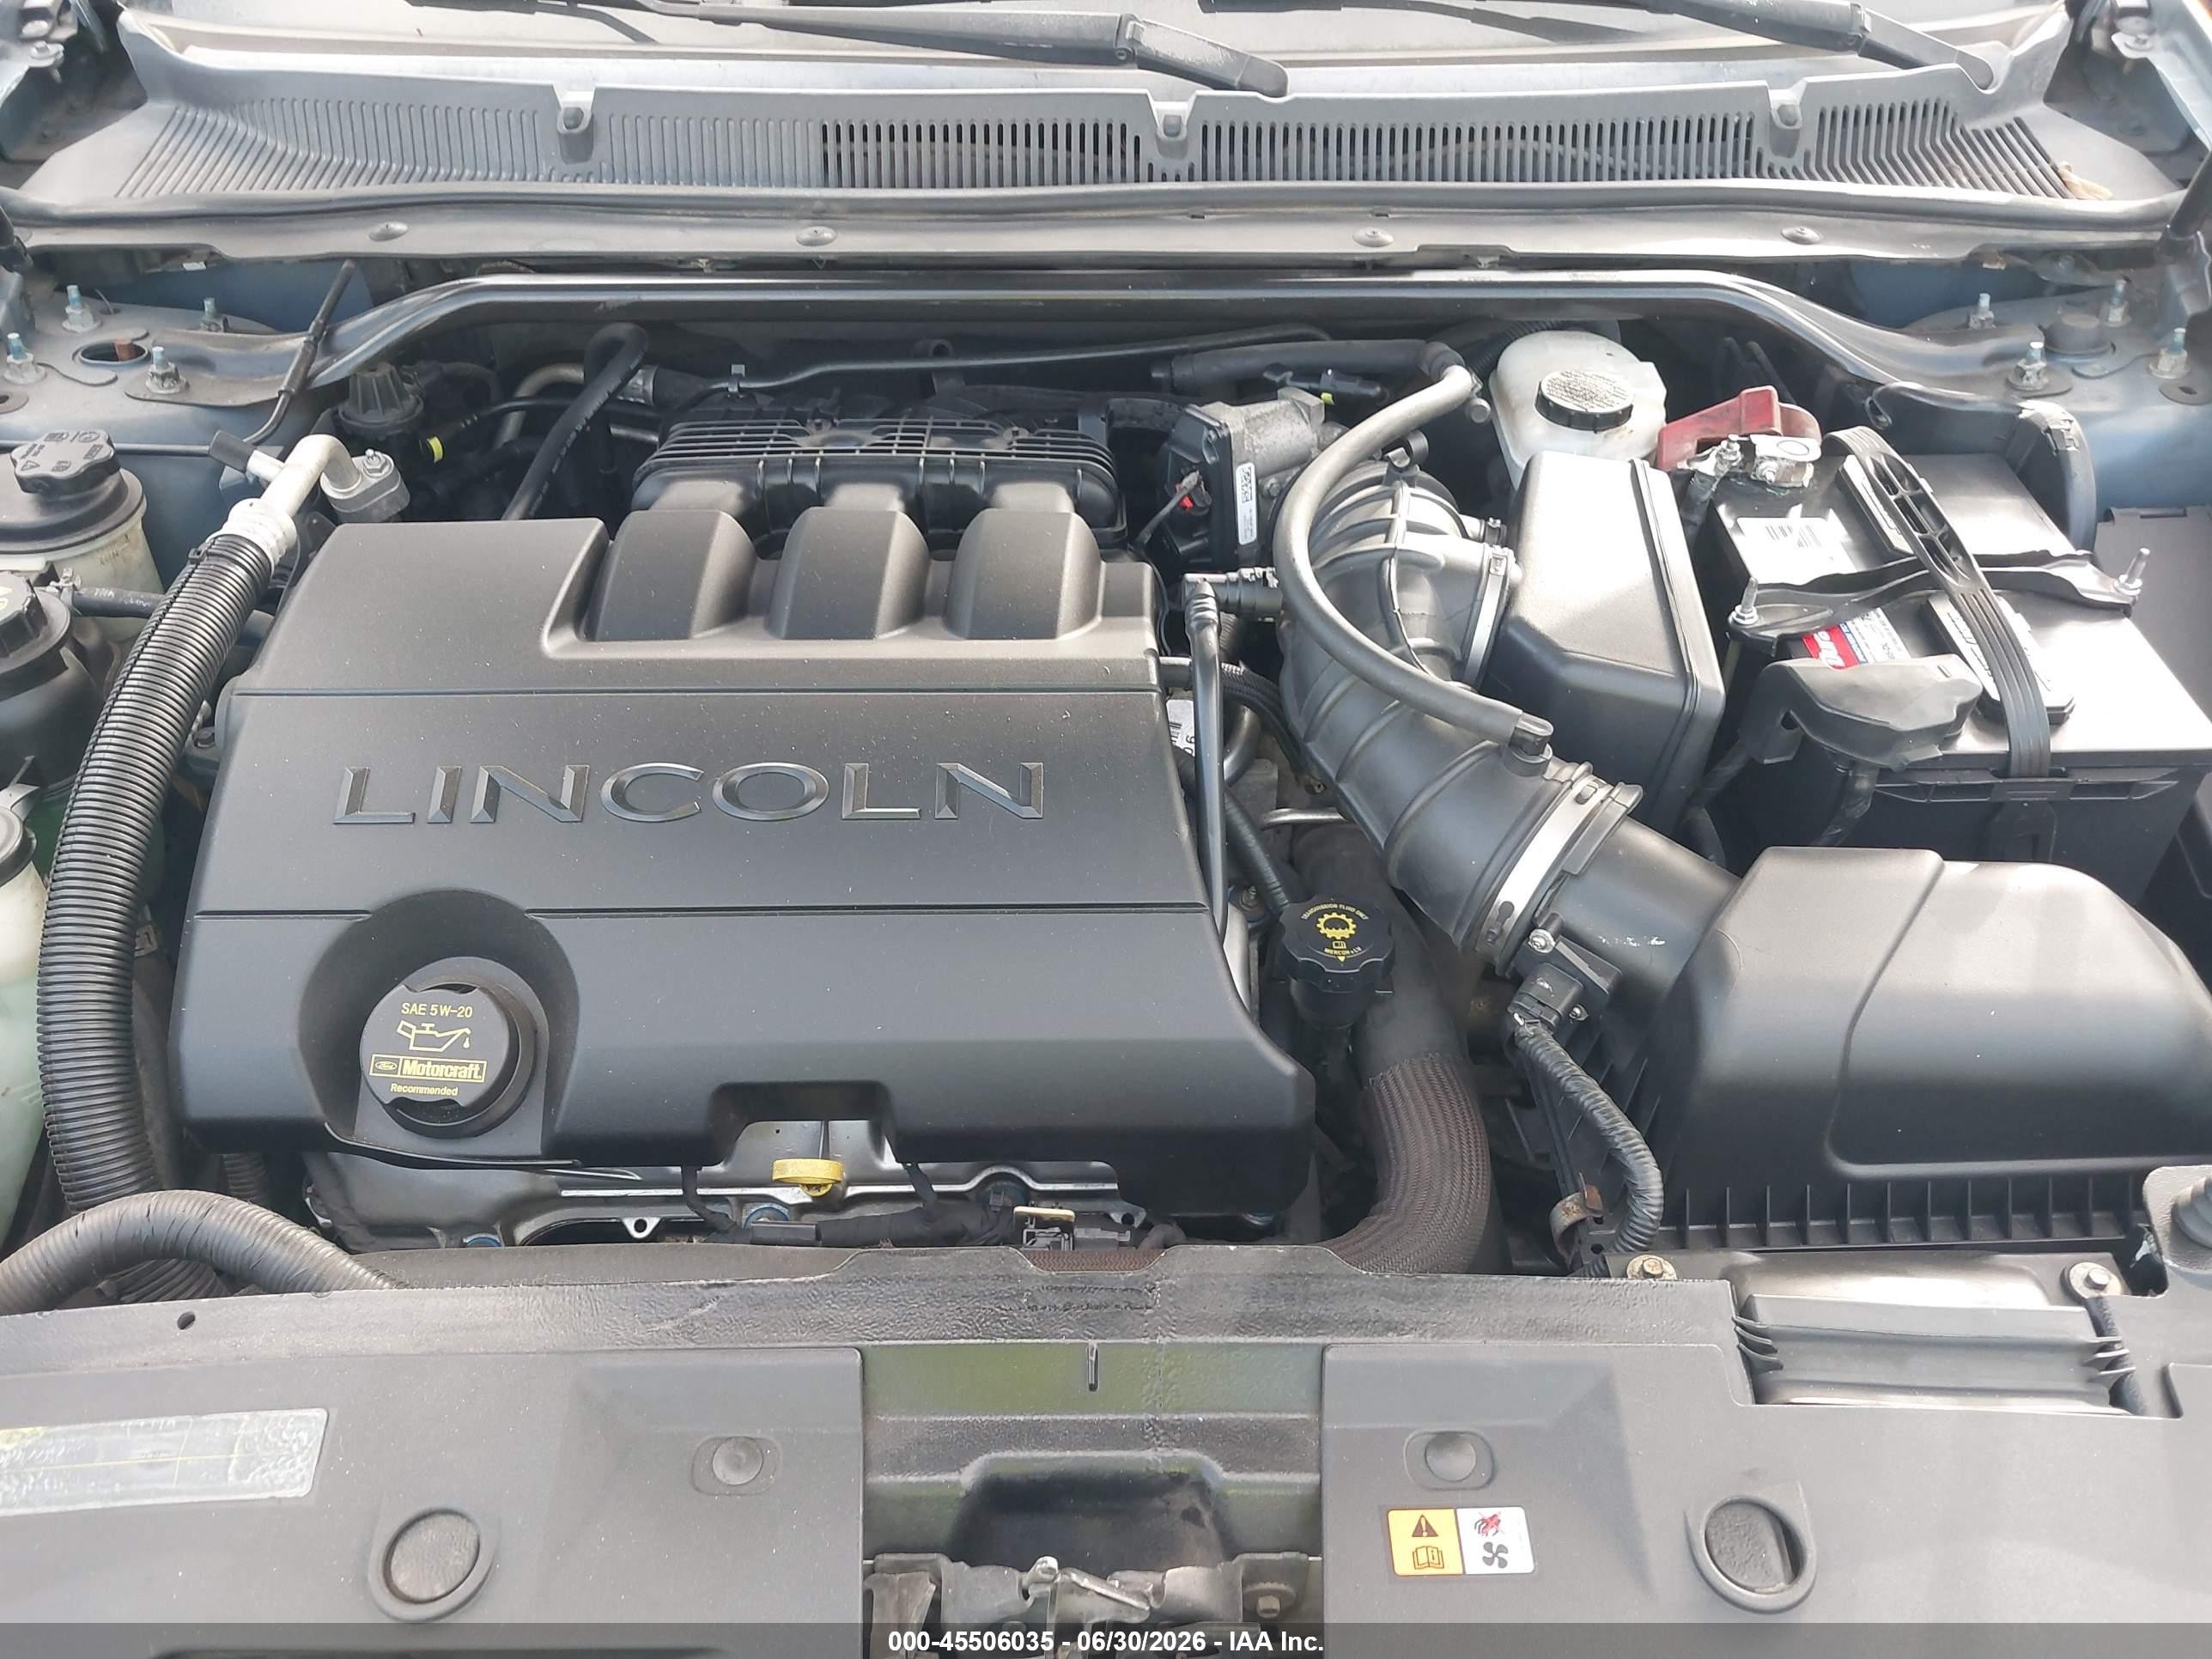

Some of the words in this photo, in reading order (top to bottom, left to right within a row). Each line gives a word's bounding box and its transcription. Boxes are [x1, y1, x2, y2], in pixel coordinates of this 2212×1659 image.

[333, 763, 1044, 824] LINCOLN
[1301, 902, 1338, 921] TRANSMISSION
[1339, 903, 1356, 912] FLUID
[1355, 908, 1370, 921] ONLY
[401, 1002, 427, 1016] SAE
[430, 1003, 473, 1018] 5W-20
[390, 1083, 459, 1096] Recommended
